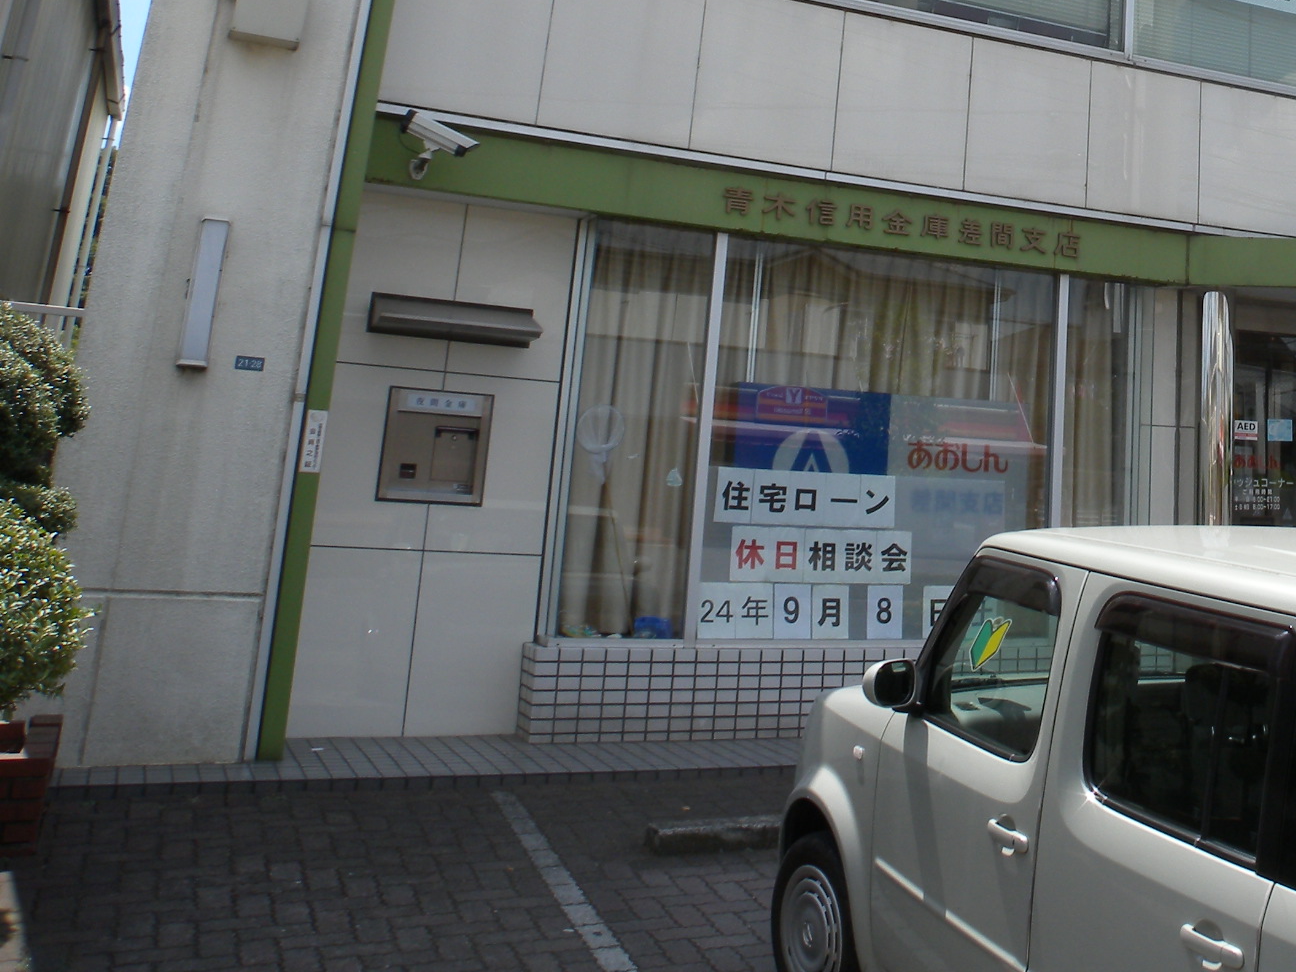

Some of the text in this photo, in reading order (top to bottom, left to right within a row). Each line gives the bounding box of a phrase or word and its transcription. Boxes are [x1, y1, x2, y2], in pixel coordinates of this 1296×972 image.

[722, 185, 1082, 259] 青木信用金庫差間支店
[1236, 422, 1256, 431] AED
[907, 439, 1009, 474] あおしん
[721, 479, 891, 514] 住宅ローン
[735, 537, 909, 573] 休日相談会
